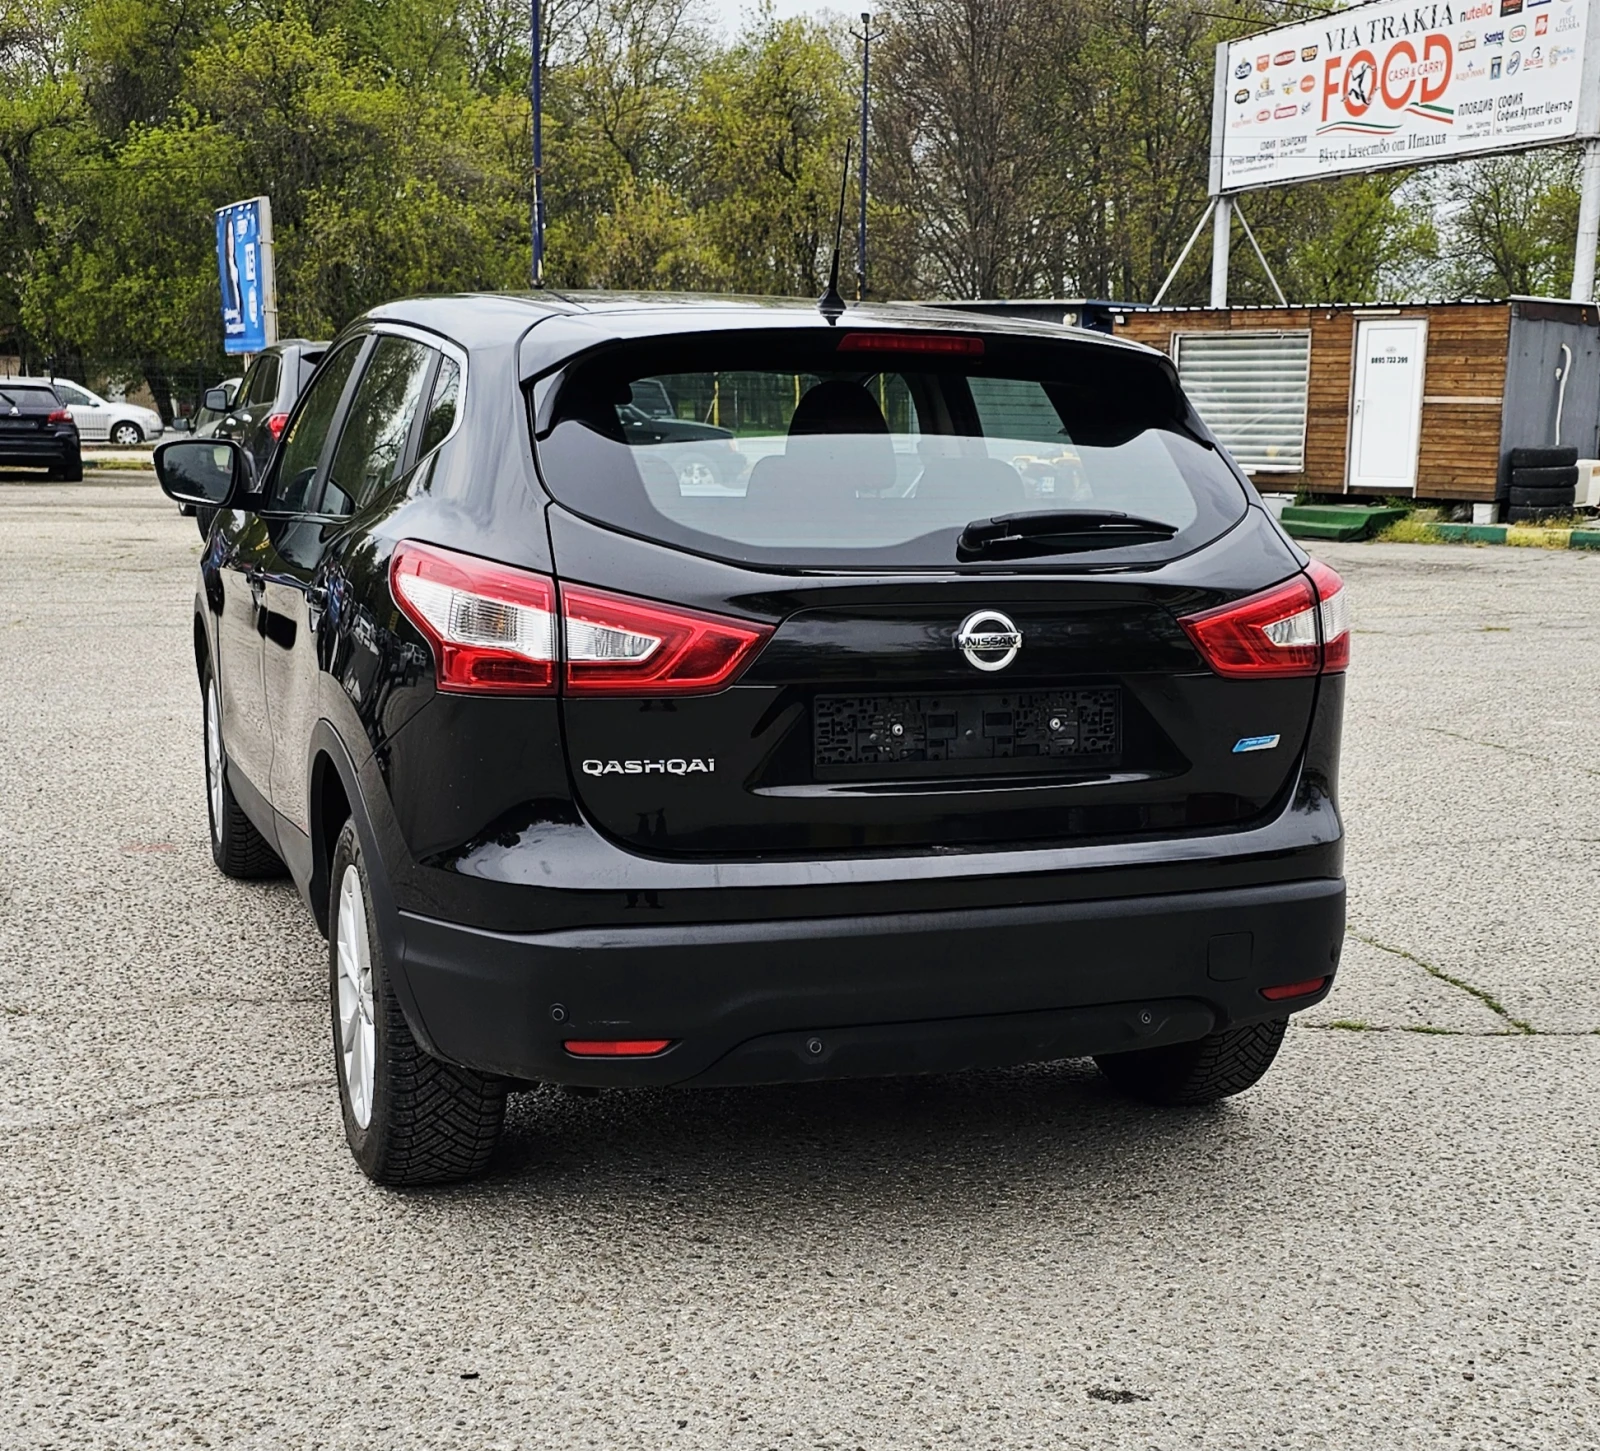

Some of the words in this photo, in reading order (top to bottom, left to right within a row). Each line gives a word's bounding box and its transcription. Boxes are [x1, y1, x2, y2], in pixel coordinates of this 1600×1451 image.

[1460, 4, 1493, 22] nutella
[1325, 25, 1361, 52] VIA
[1367, 2, 1454, 44] TRAKIA
[1321, 33, 1453, 122] FOOD
[1388, 66, 1409, 82] CASH
[1417, 61, 1445, 75] CARRY
[1458, 98, 1493, 116] ПЛОВДИВ
[1498, 92, 1523, 109] СОФИЯ
[1497, 109, 1518, 123] София
[1544, 100, 1573, 114] Център
[1319, 149, 1339, 166] Вкус
[1348, 138, 1389, 158] качество
[1391, 141, 1405, 151] от
[1408, 134, 1447, 149] Италия
[965, 635, 1018, 648] NISSAN
[582, 758, 715, 777] QASHQAI
